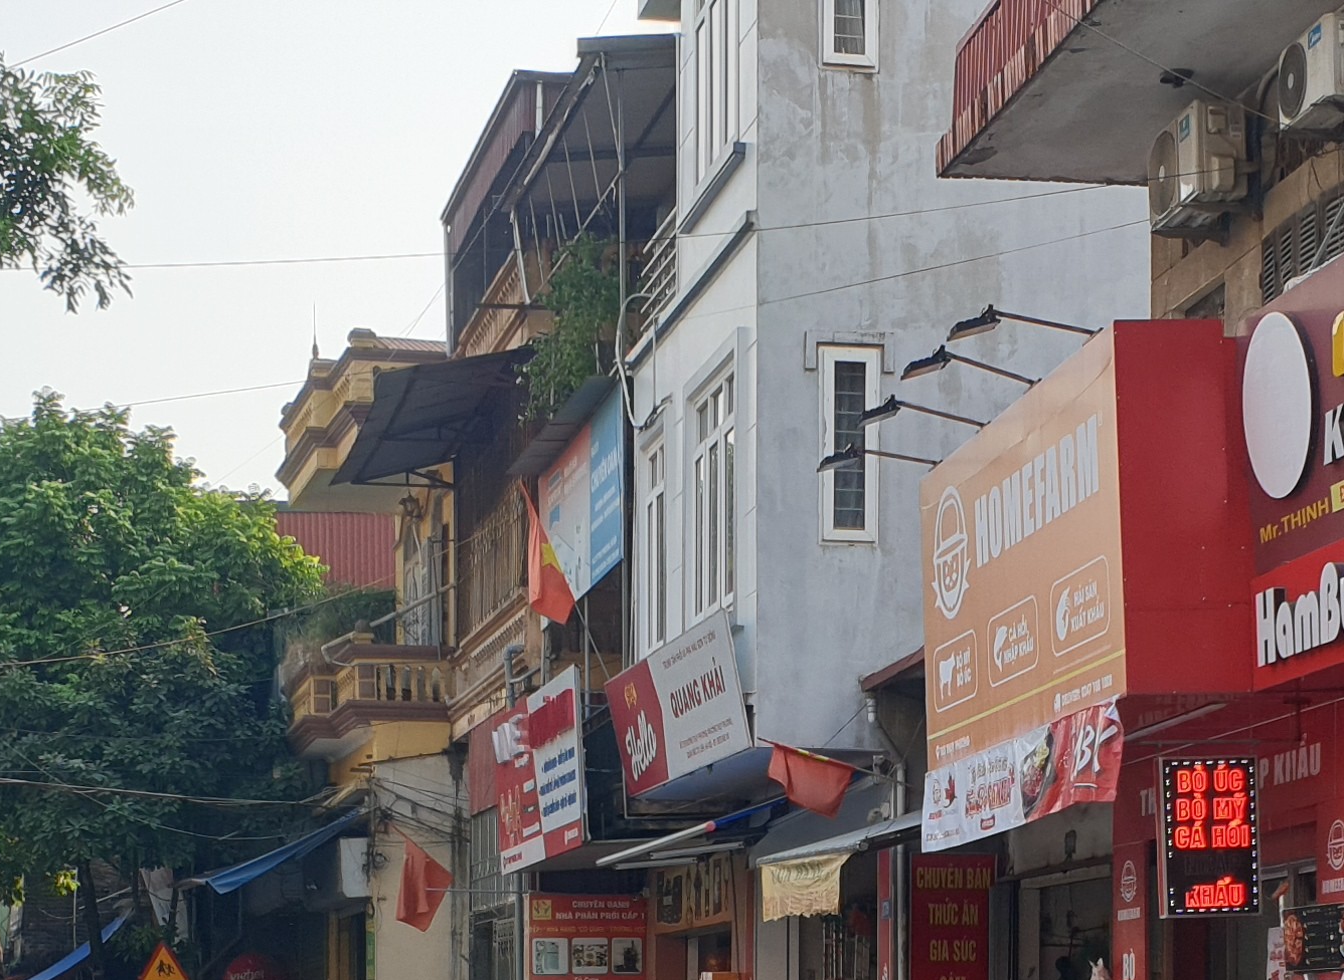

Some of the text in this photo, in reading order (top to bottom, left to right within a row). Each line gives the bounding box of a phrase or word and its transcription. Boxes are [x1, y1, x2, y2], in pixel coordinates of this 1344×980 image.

[974, 423, 1100, 567] HOMEFARM
[670, 656, 726, 719] QUANG KHẢI
[625, 709, 656, 782] Hello
[1176, 765, 1207, 793] BÒ
[1213, 764, 1244, 791] ÚC
[1176, 793, 1206, 821] BÒ
[1213, 793, 1246, 820] MỸ
[1175, 819, 1250, 848] CÁ HỒI
[916, 865, 991, 889] CHUYÊN BÁN
[928, 898, 959, 925] THỨC
[930, 936, 977, 961] GIA SÚC
[1122, 948, 1135, 980] BÒ
